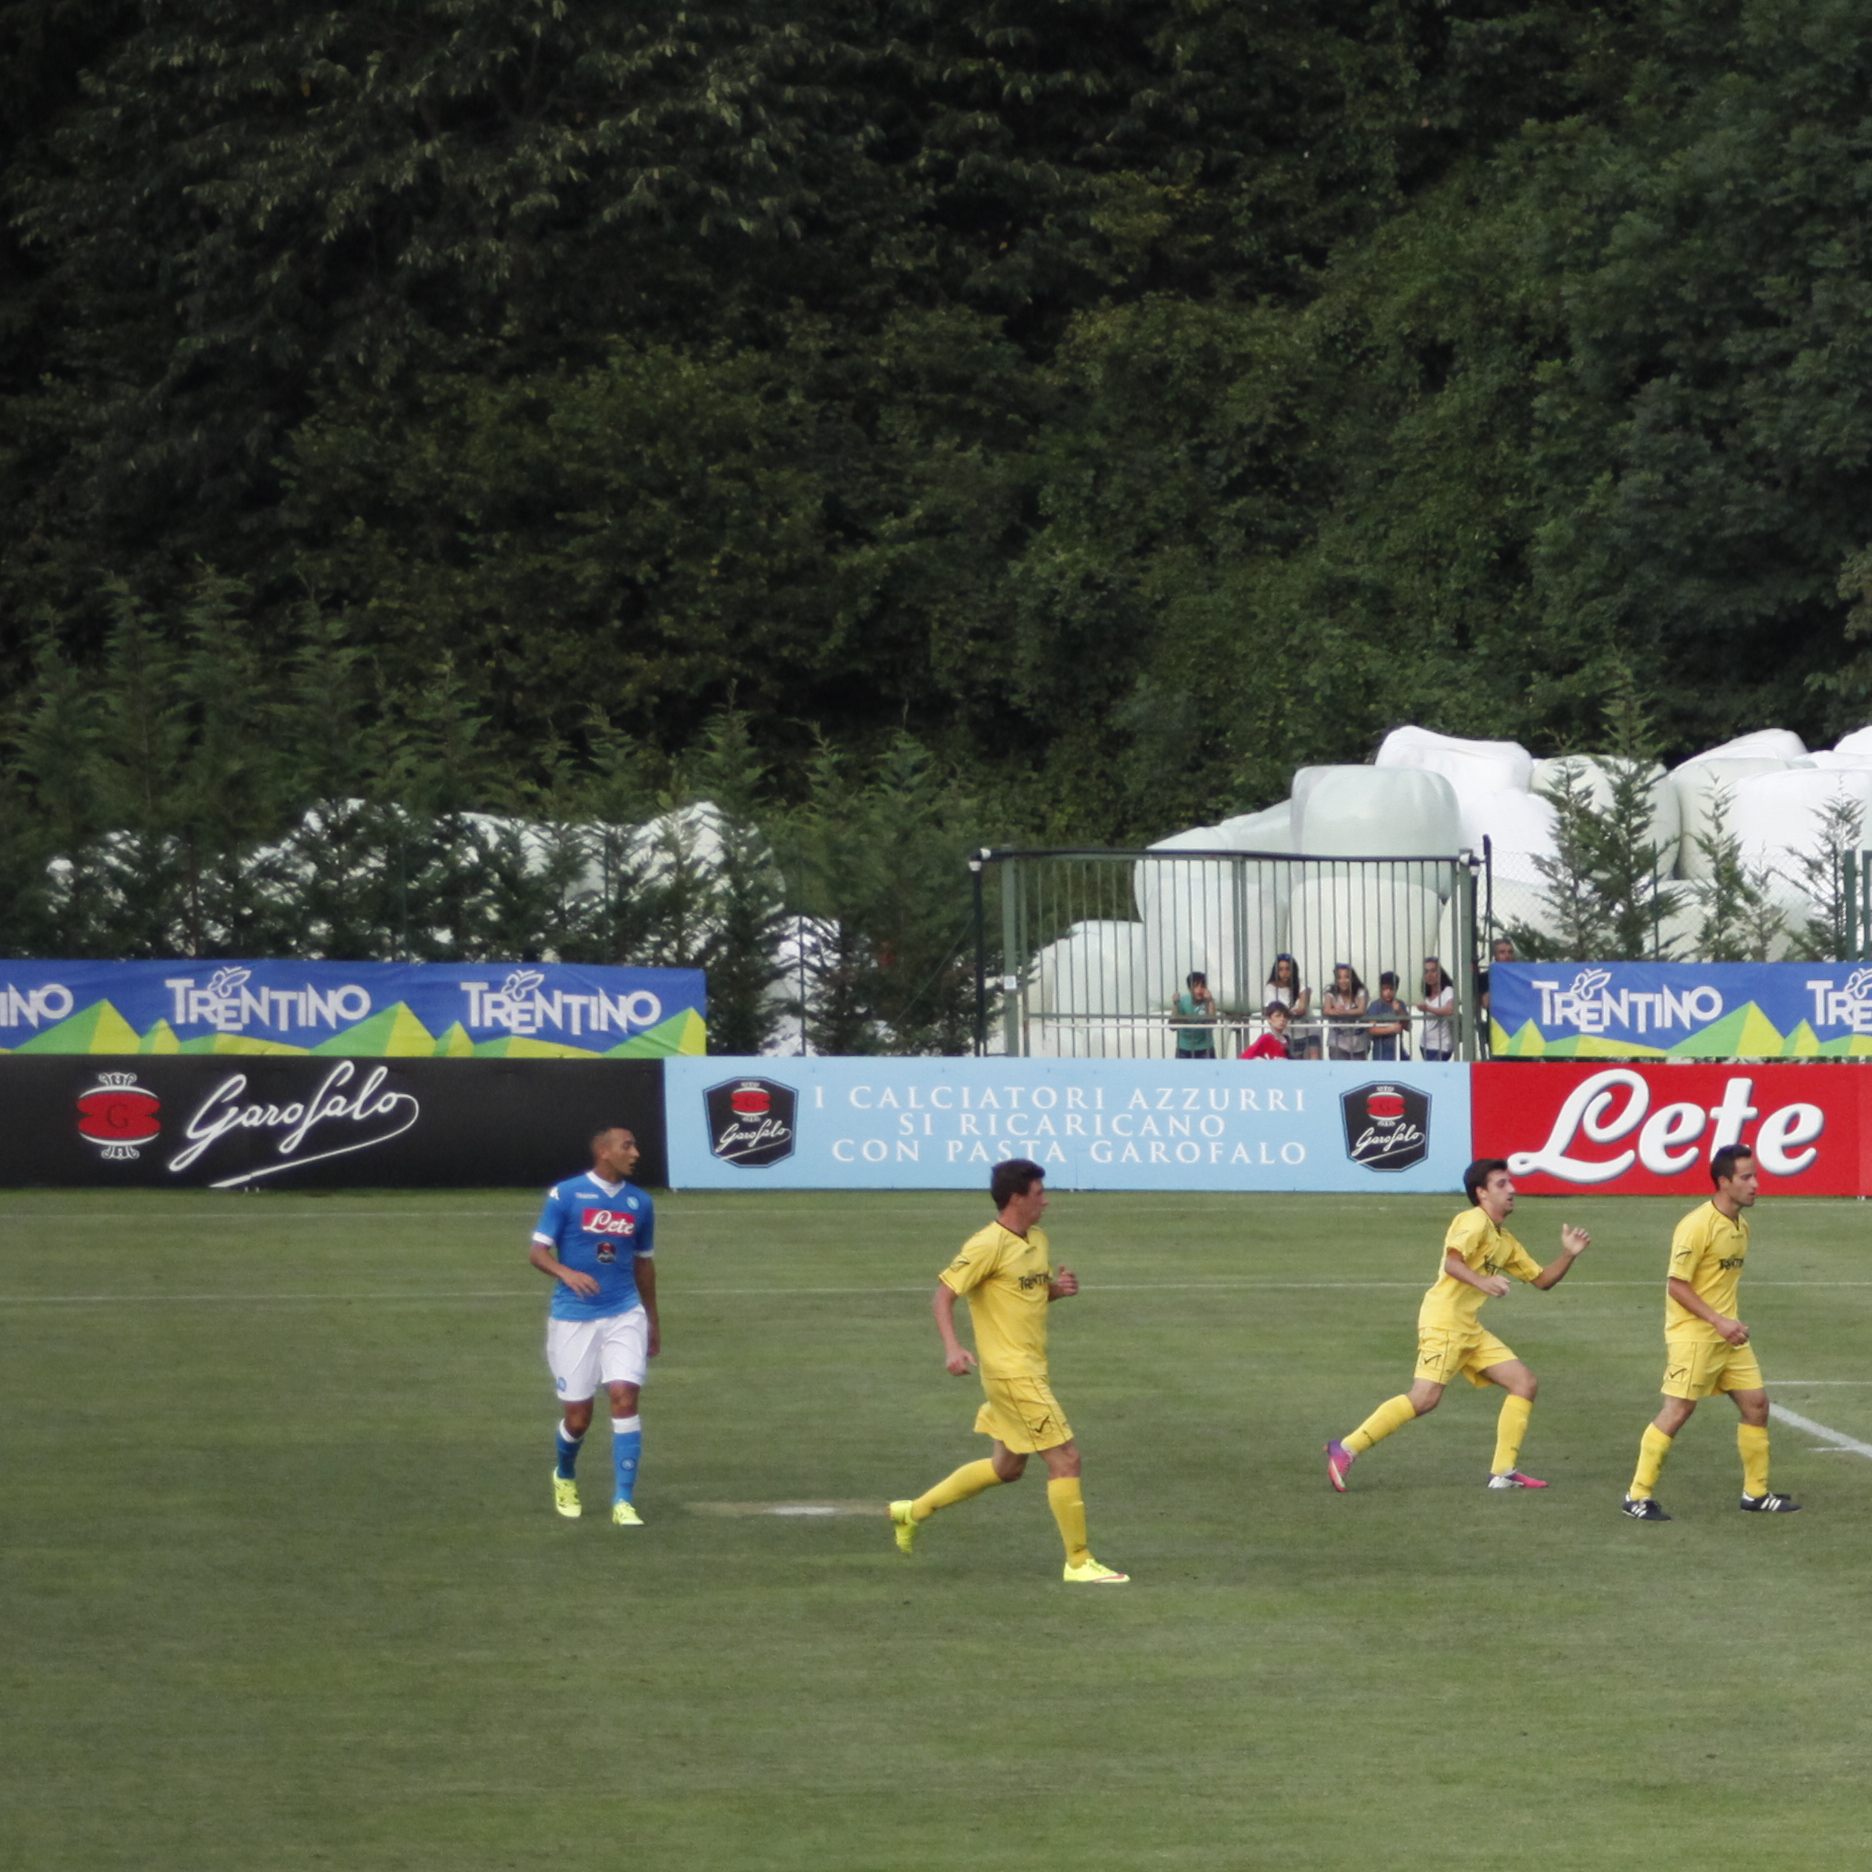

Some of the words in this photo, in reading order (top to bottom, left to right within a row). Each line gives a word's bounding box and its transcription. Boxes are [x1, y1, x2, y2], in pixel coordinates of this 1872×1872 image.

[165, 979, 371, 1032] TRENTINO
[460, 981, 661, 1035] TRENTINO
[1532, 980, 1723, 1033] TRENTINO
[815, 1086, 824, 1109] I
[850, 1085, 1104, 1110] CALCIATORI
[1128, 1087, 1306, 1112] AZZURRI
[168, 1061, 419, 1188] Garofalo
[715, 1118, 791, 1160] Garofalo
[898, 1113, 933, 1136] SI
[960, 1113, 1226, 1138] RICARICANO
[1351, 1123, 1425, 1164] Garofalo
[1507, 1067, 1824, 1184] Lete
[832, 1139, 920, 1163] CON
[946, 1140, 1067, 1163] PASTA
[1090, 1140, 1306, 1165] GAROFALO
[582, 1210, 635, 1235] Lete
